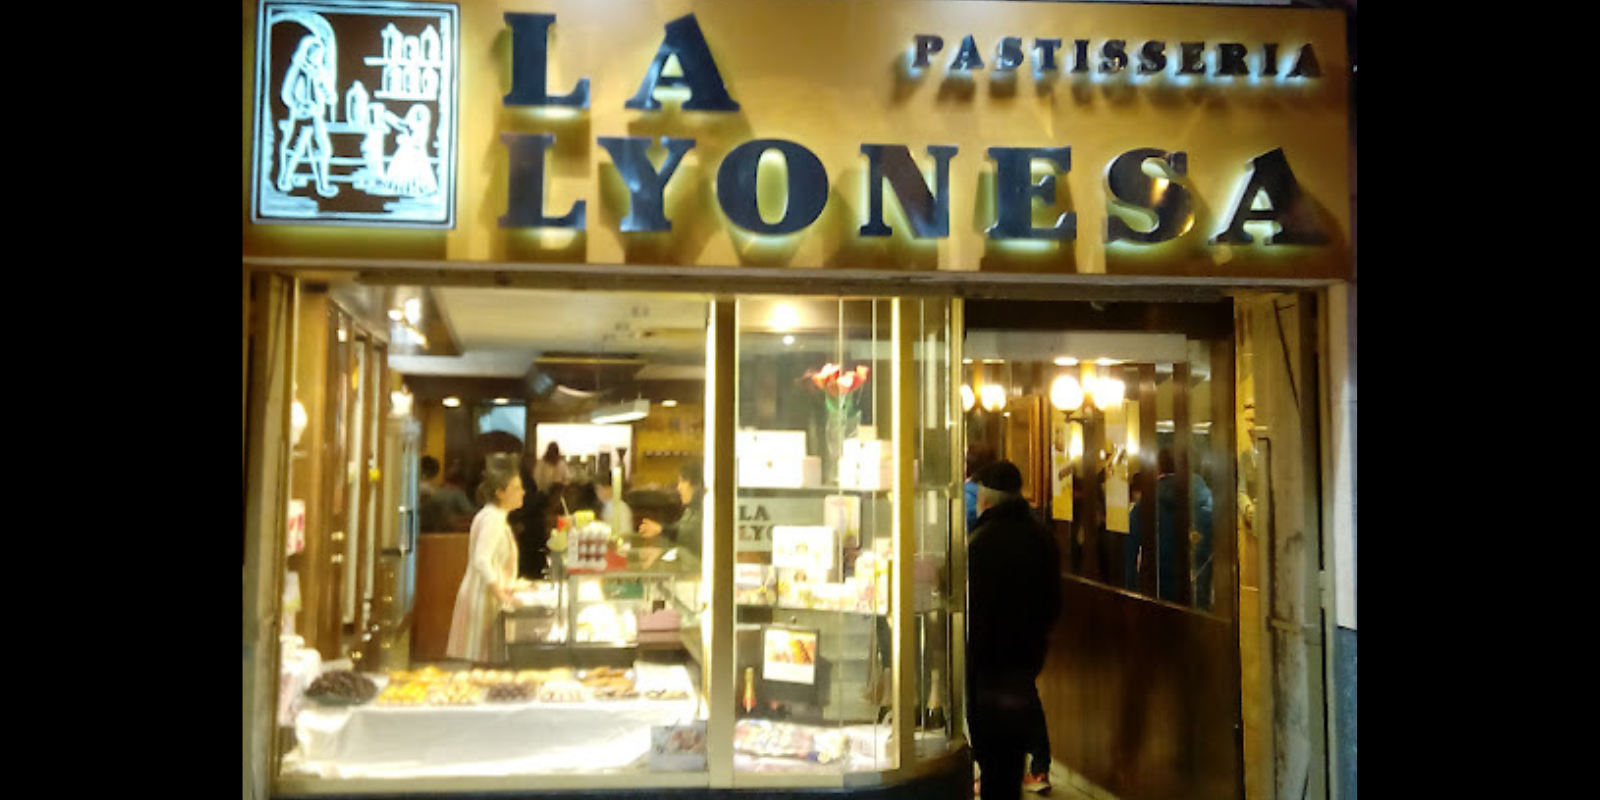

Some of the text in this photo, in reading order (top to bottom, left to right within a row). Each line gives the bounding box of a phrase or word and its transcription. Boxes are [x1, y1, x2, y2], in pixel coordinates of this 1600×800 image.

[503, 12, 740, 112] LA
[910, 34, 1323, 79] PASTISSERIA
[498, 133, 1331, 247] LYONESA
[739, 505, 770, 521] LA
